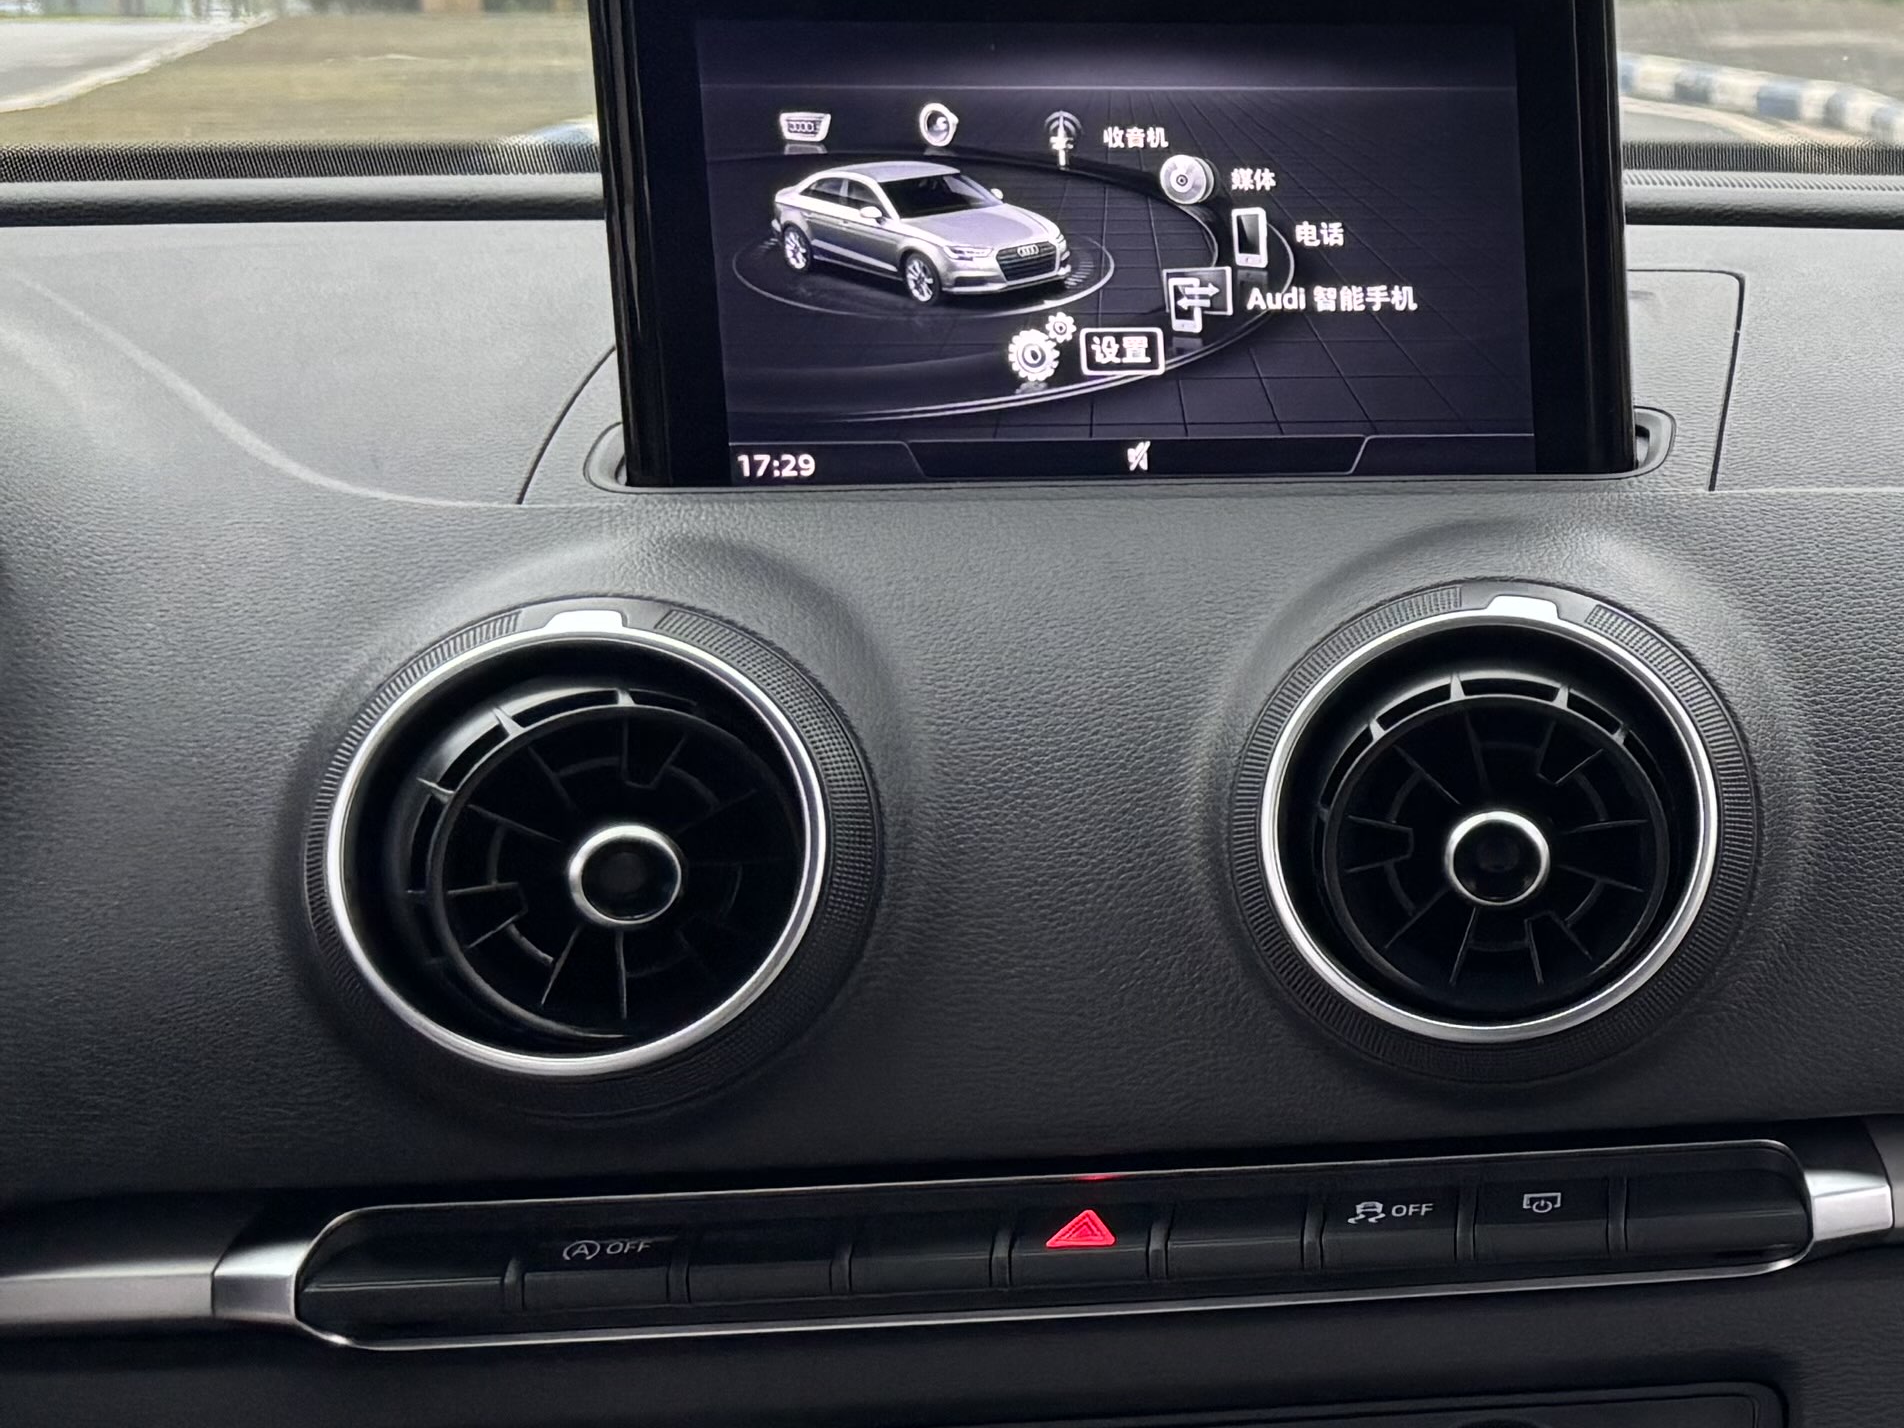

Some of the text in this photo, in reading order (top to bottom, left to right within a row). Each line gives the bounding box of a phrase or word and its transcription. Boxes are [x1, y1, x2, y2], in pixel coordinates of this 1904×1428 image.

[1103, 126, 1169, 149] 收音机
[1230, 167, 1276, 191] 媒体
[1295, 221, 1344, 247] 电话
[1246, 285, 1418, 312] Audi 智能手机
[1090, 335, 1152, 364] 设置
[737, 453, 816, 478] 17:29
[1391, 1203, 1434, 1217] OFF
[606, 1241, 651, 1255] OFF
